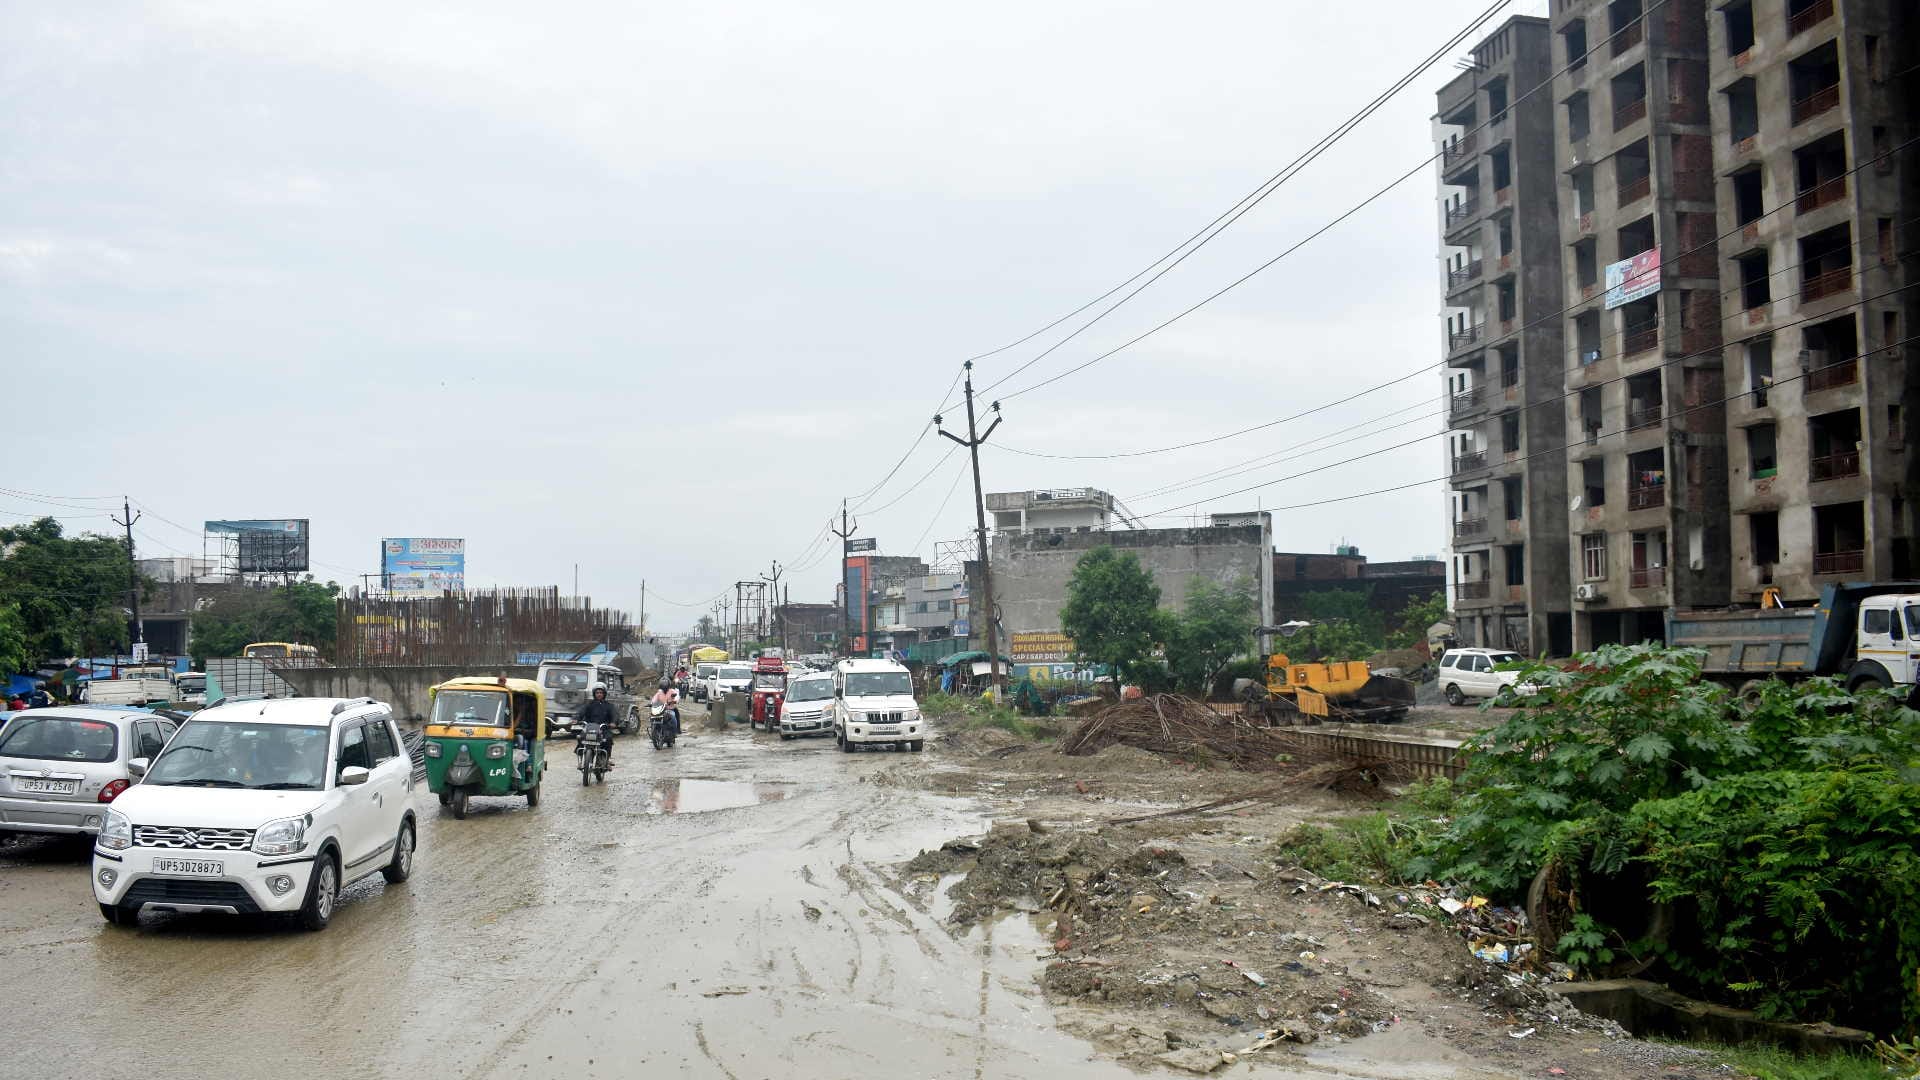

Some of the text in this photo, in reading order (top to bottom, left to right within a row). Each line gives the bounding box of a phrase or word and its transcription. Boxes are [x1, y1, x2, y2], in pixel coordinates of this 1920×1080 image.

[1013, 644, 1044, 652] SPECIAL
[489, 768, 507, 776] LPG
[160, 861, 222, 873] UP53DZ8873
